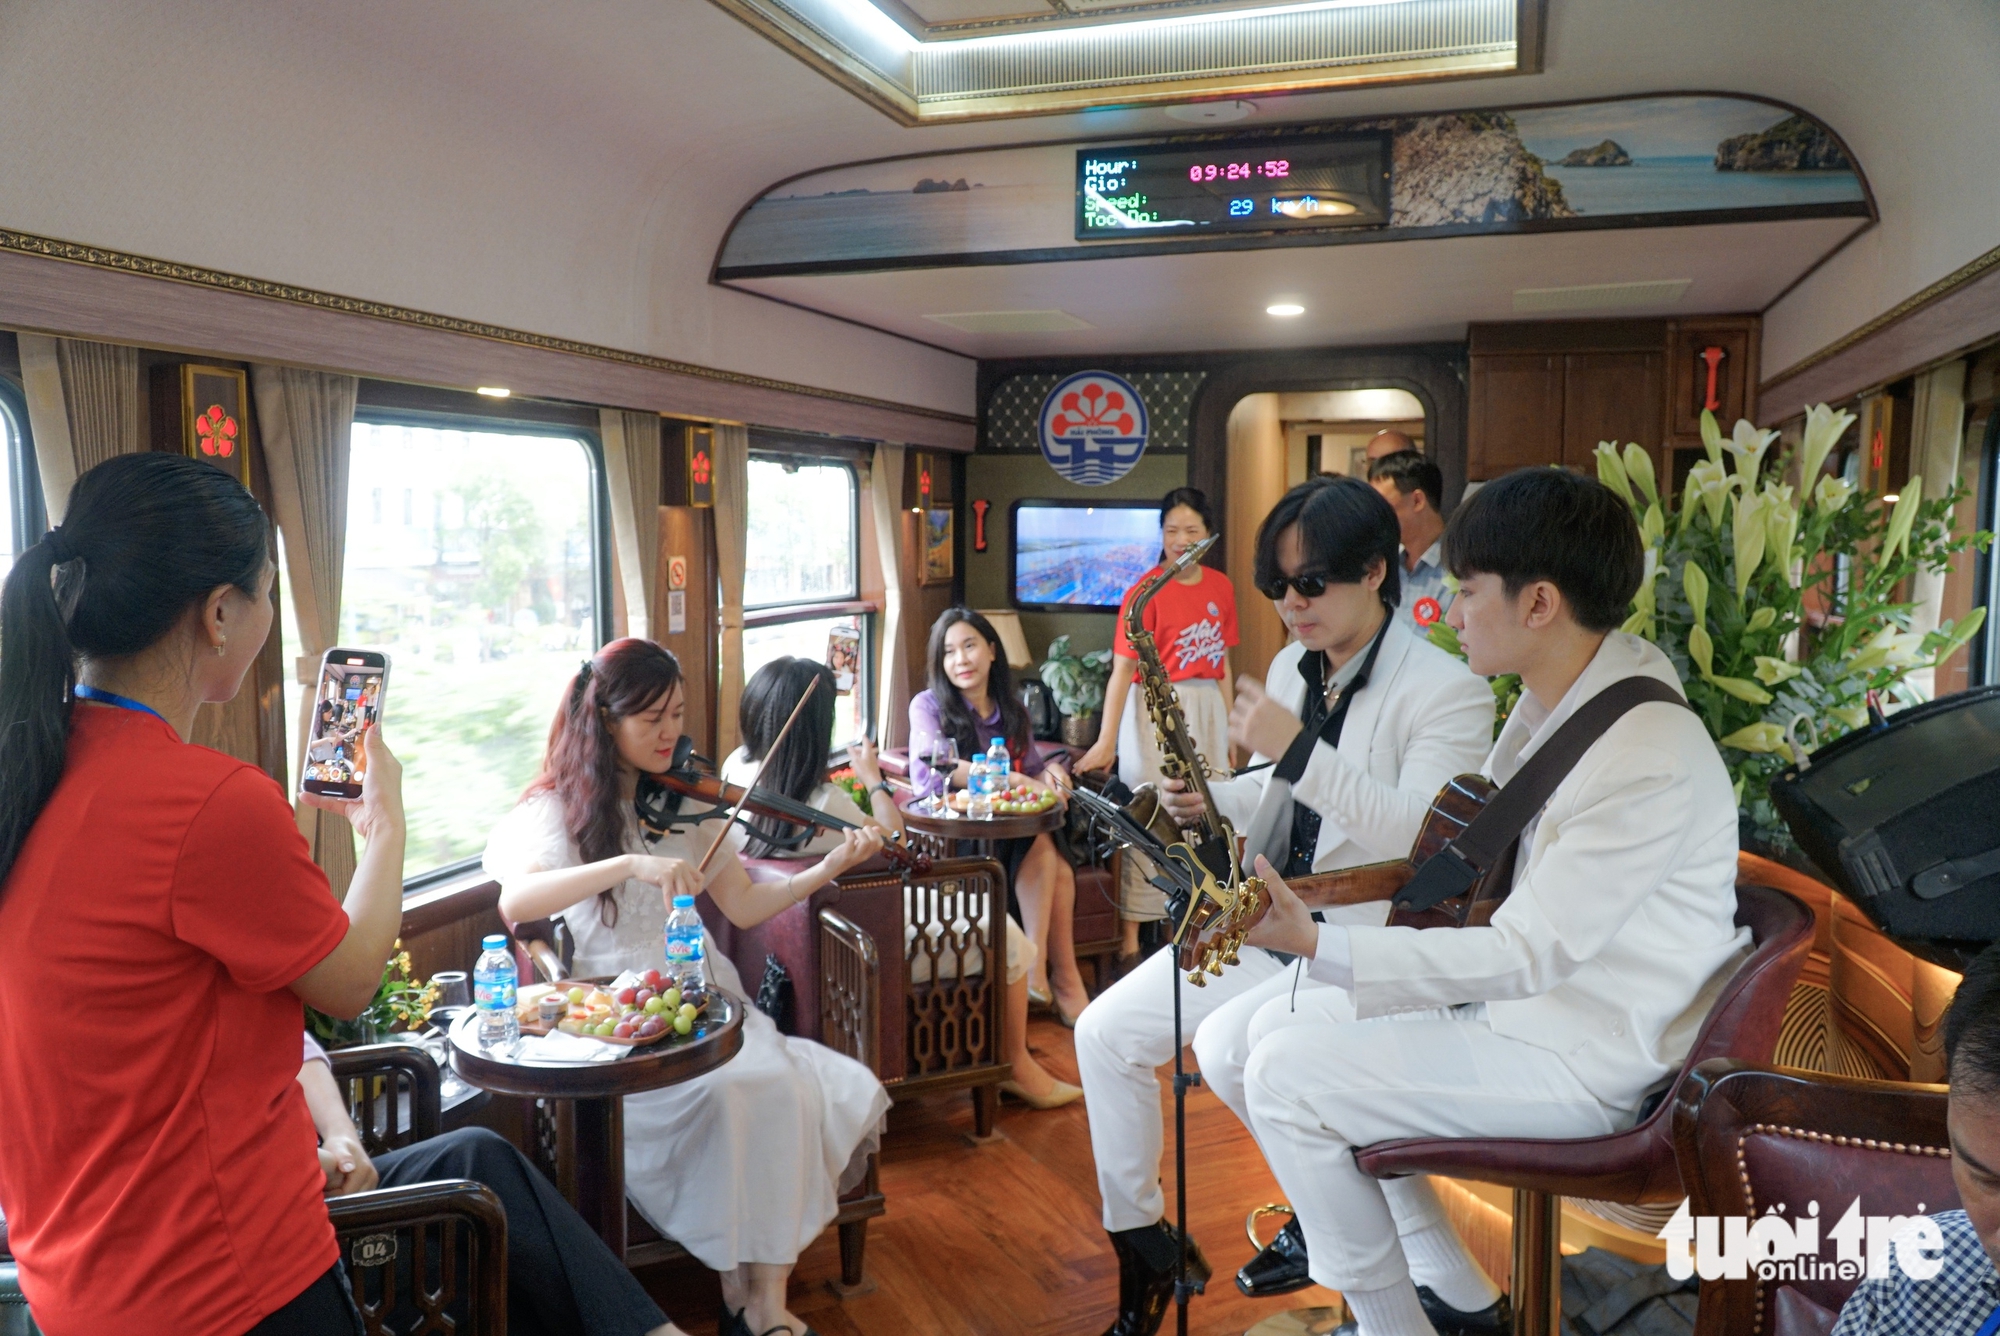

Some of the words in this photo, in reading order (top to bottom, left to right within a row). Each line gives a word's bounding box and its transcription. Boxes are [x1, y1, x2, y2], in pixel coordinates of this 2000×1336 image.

[1085, 160, 1137, 176] Hour:
[1084, 175, 1126, 194] Gio:
[1230, 199, 1253, 216] 29
[362, 1242, 387, 1259] 04
